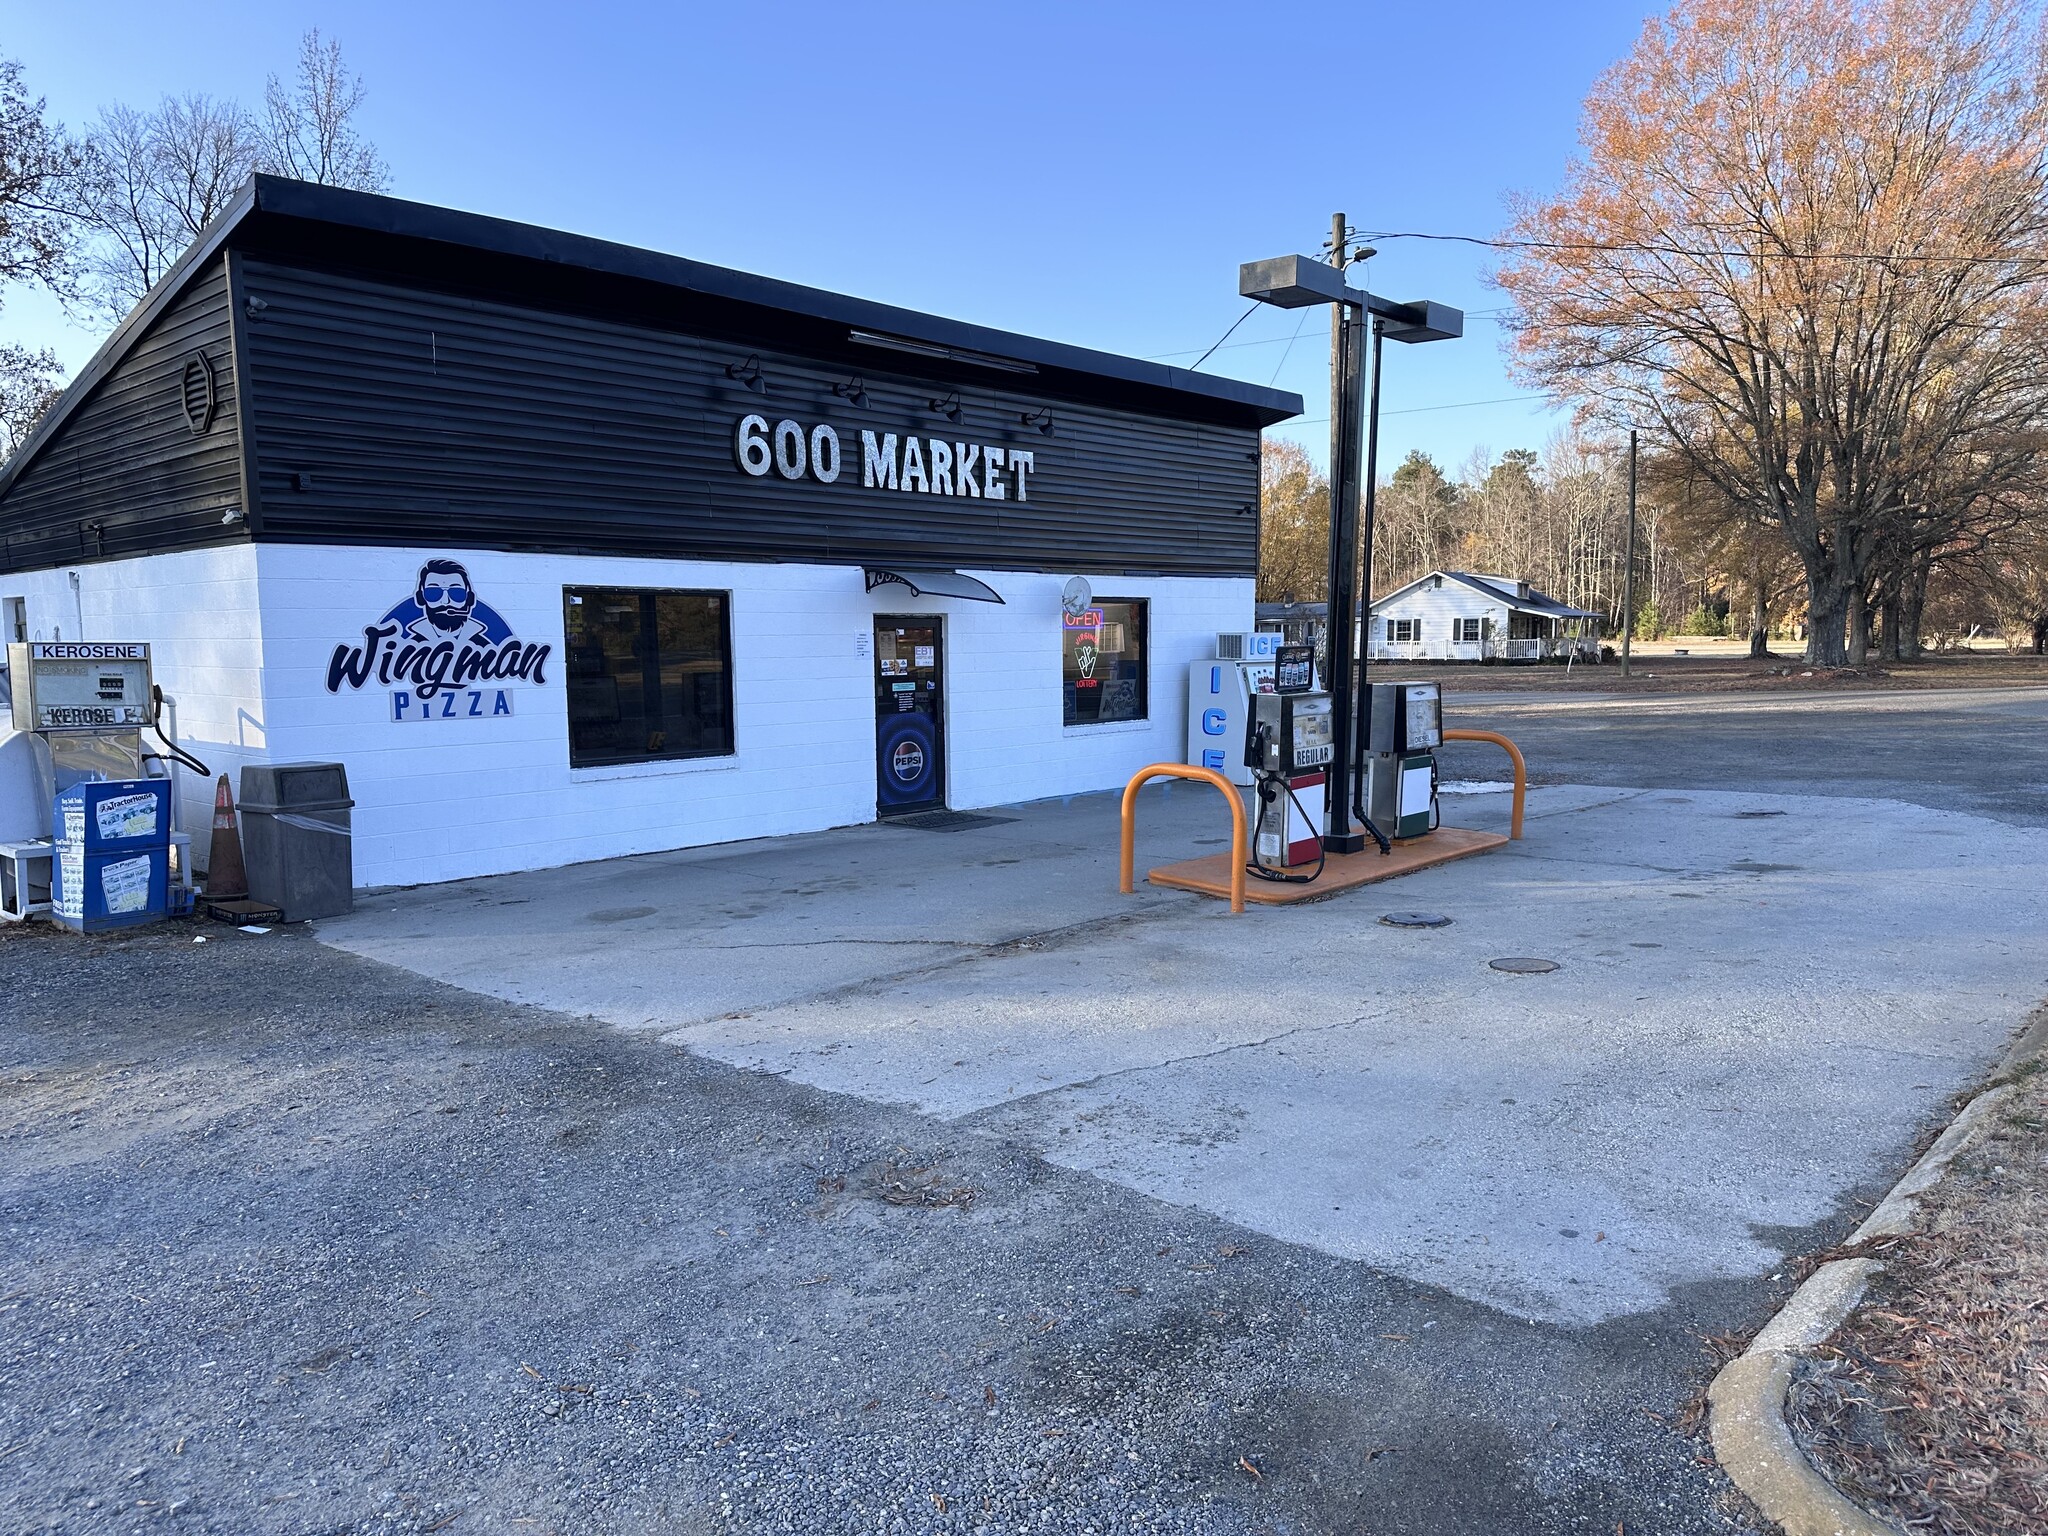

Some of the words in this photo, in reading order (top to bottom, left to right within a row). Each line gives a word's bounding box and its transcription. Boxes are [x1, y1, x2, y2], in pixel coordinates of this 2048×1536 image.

[735, 414, 841, 483] 600
[861, 429, 1034, 502] MARKET
[42, 645, 138, 658] KEROSENE
[915, 647, 934, 656] EBT
[1250, 636, 1282, 655] ICE
[326, 623, 552, 700] Wingman
[1076, 680, 1098, 688] LOTTERY
[393, 690, 511, 721] PIZZA
[1414, 735, 1431, 743] DIESEL
[895, 756, 922, 767] PEPSI
[1296, 747, 1329, 766] REGULAR
[109, 792, 153, 810] TractorHouse
[119, 859, 138, 868] Paper
[248, 911, 278, 919] MONSTER
